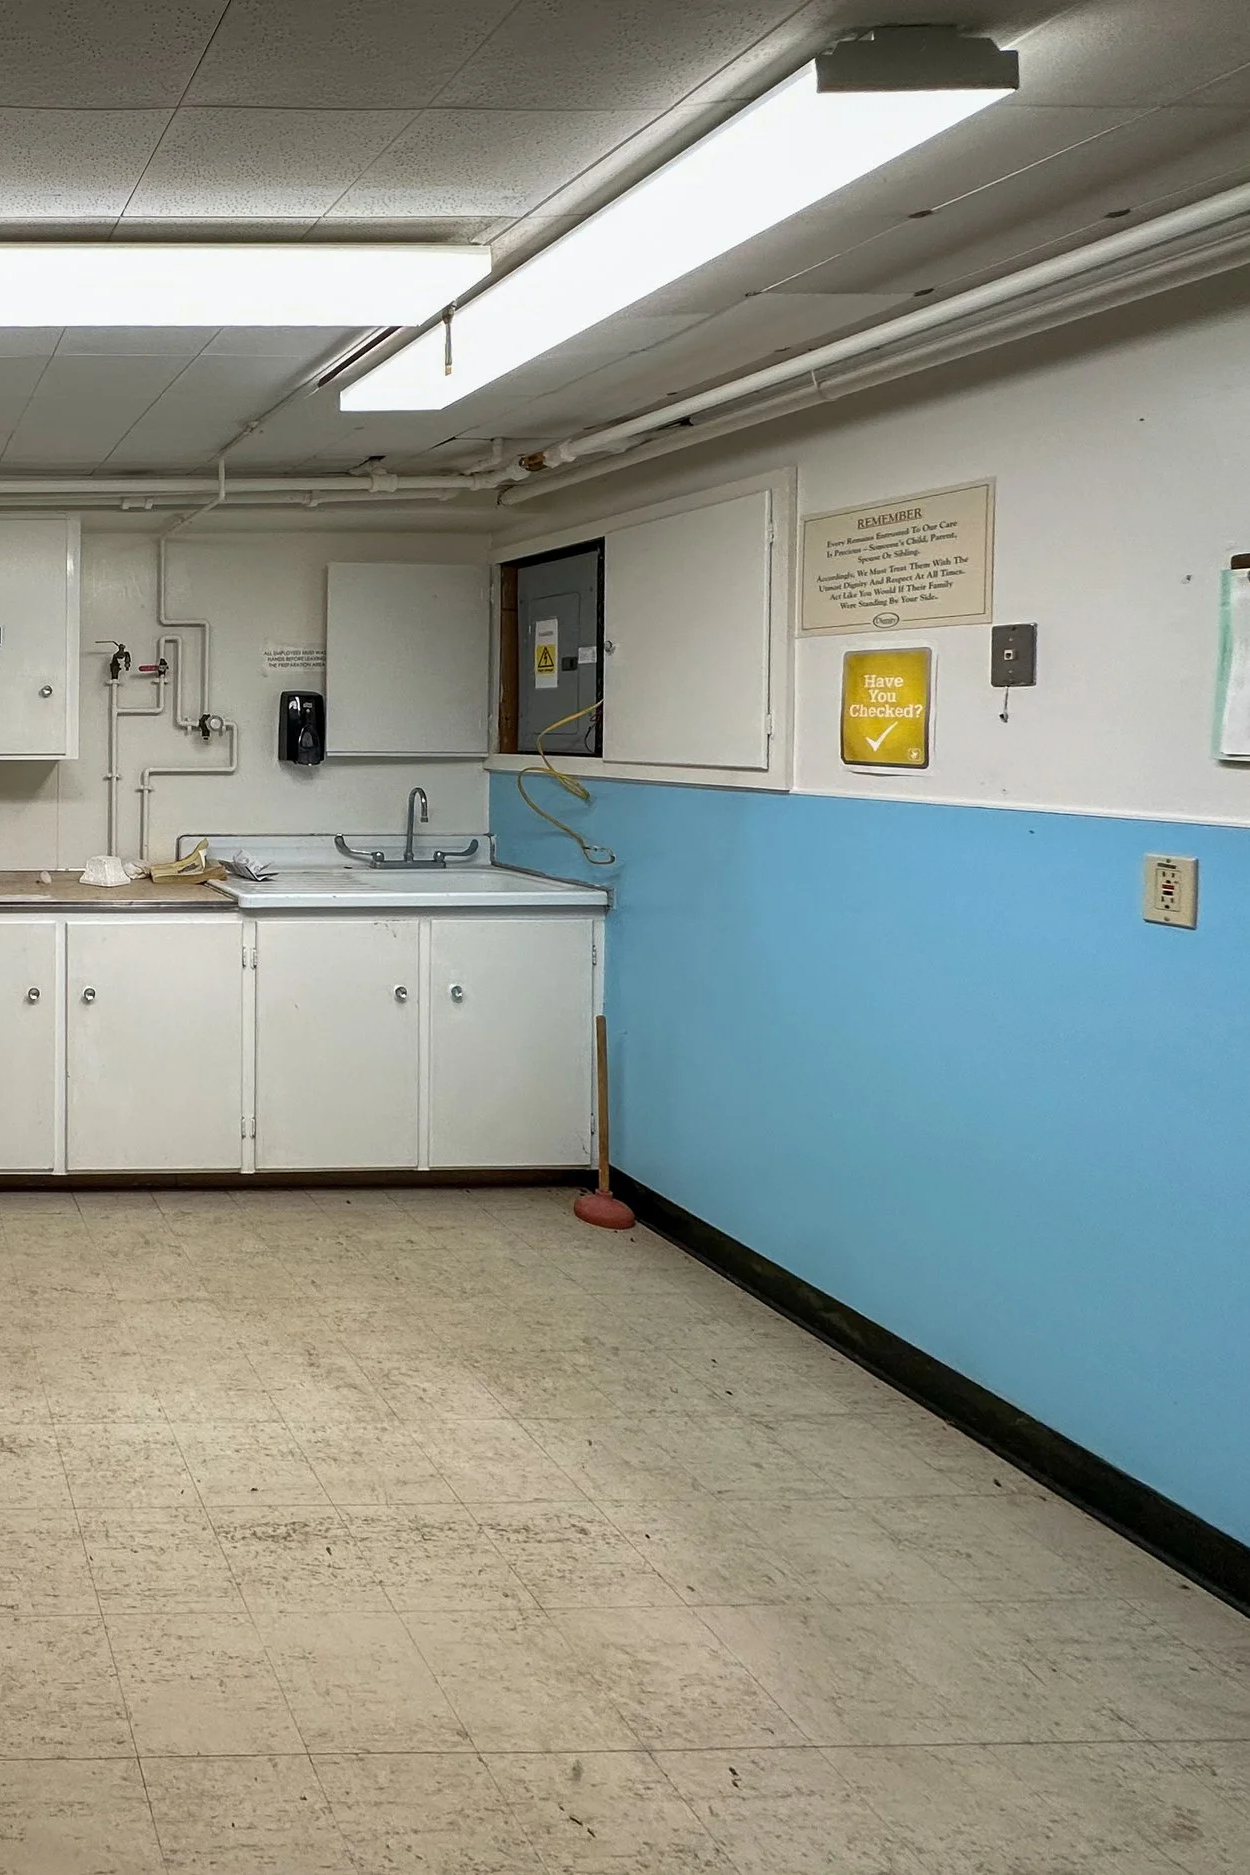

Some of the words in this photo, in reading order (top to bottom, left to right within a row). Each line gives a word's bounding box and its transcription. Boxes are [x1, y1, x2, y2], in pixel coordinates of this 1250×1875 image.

[857, 508, 922, 528] REMEMBER
[827, 540, 845, 549] Every
[847, 535, 874, 544] Remains
[876, 528, 909, 540] Entrusted
[911, 526, 921, 534] To
[922, 523, 938, 532] Our
[939, 520, 958, 529] Care
[834, 548, 862, 557] Precious
[857, 555, 880, 565] Spouse
[882, 551, 892, 559] Or
[857, 569, 868, 577] We
[889, 565, 907, 573] Treat
[909, 562, 930, 571] Them
[932, 557, 951, 567] With
[954, 556, 969, 565] The
[819, 583, 842, 593] Utmost
[843, 580, 867, 590] Dignity
[869, 577, 884, 586] And
[885, 575, 913, 585] Respect
[914, 572, 925, 580] At
[926, 569, 939, 579] All
[829, 593, 842, 601] Act
[843, 590, 857, 600] Like
[859, 590, 872, 598] You
[873, 586, 896, 596] Would
[898, 585, 905, 593] If
[906, 583, 927, 593] Their
[928, 580, 954, 590] Family
[840, 602, 857, 610] Were
[858, 598, 888, 608] Standing
[889, 597, 899, 605] By
[901, 595, 918, 603] Your
[919, 592, 939, 602] Side.
[863, 674, 904, 688] Have
[869, 689, 897, 703] You
[850, 704, 923, 718] Checked?
